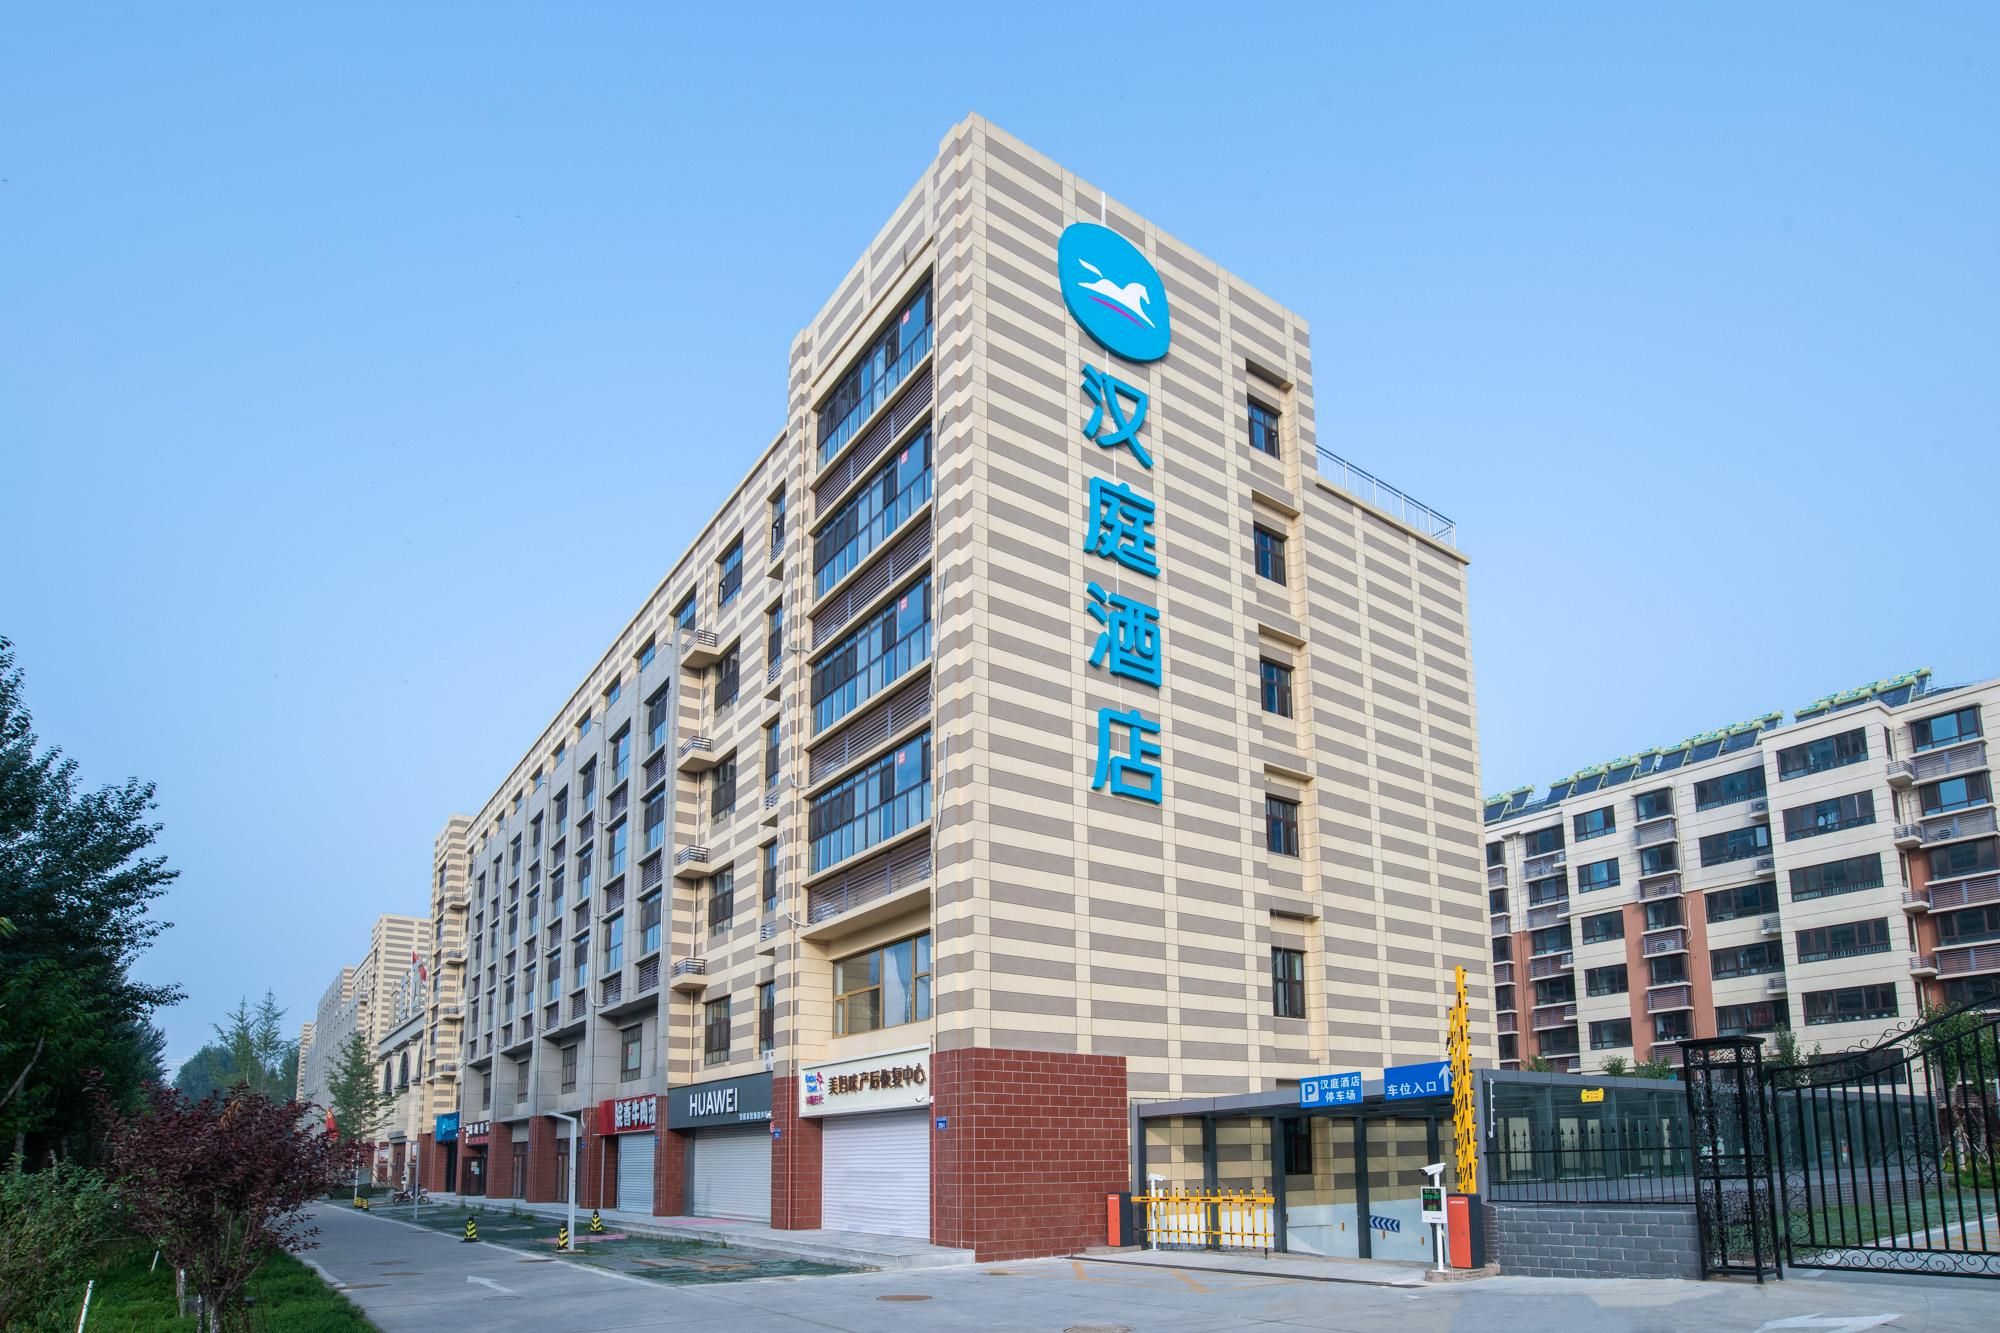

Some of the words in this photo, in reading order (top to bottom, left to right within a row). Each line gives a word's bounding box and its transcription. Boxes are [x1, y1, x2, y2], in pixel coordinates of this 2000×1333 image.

[1081, 363, 1162, 804] 汉庭酒店
[1320, 1075, 1361, 1090] 汉庭酒店
[1387, 1081, 1437, 1097] 车位入口
[689, 1087, 738, 1117] HUAWEI
[1325, 1089, 1356, 1103] 停车场
